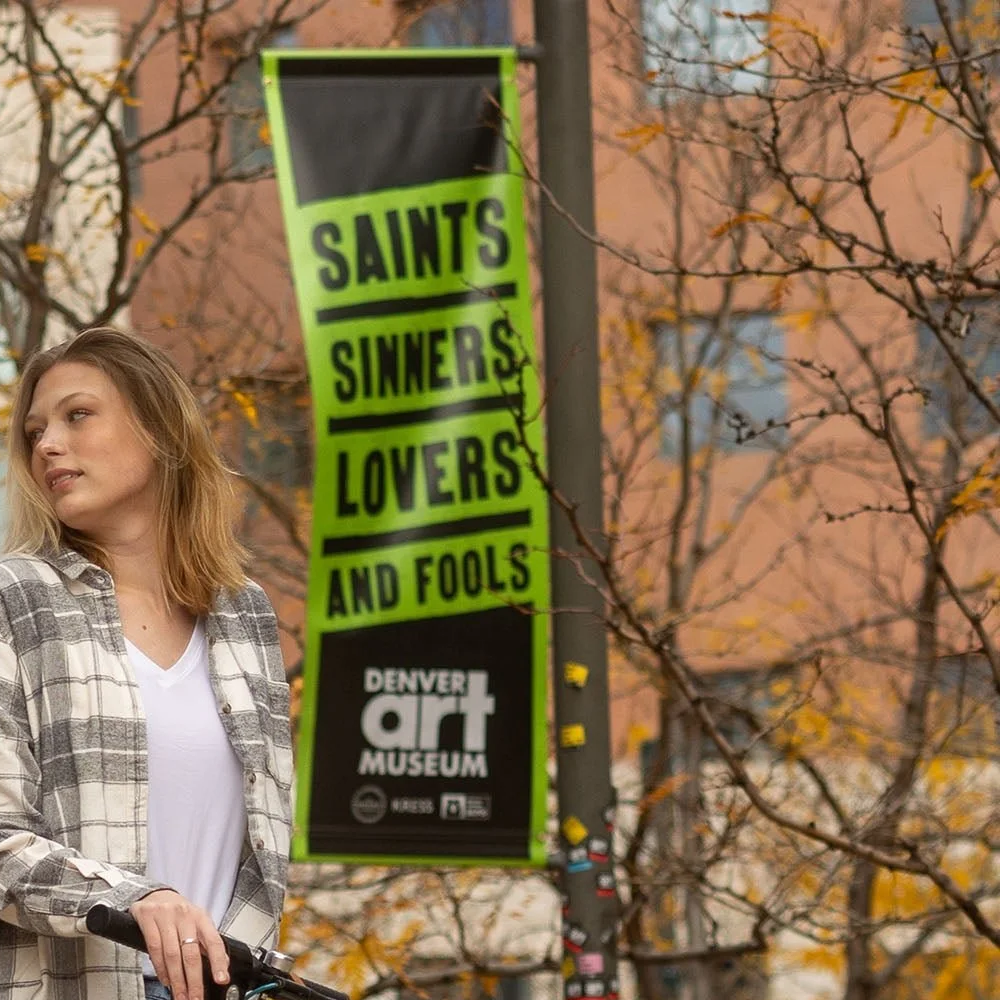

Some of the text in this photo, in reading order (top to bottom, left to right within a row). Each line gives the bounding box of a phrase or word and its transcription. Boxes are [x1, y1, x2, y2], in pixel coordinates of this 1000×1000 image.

[311, 198, 510, 291] SAINTS
[331, 318, 517, 403] SINNERS
[336, 431, 522, 518] LOVERS
[326, 543, 532, 620] AND FOOLS
[360, 670, 496, 752] art
[363, 667, 468, 695] DENVER
[357, 750, 489, 778] MUSEUM
